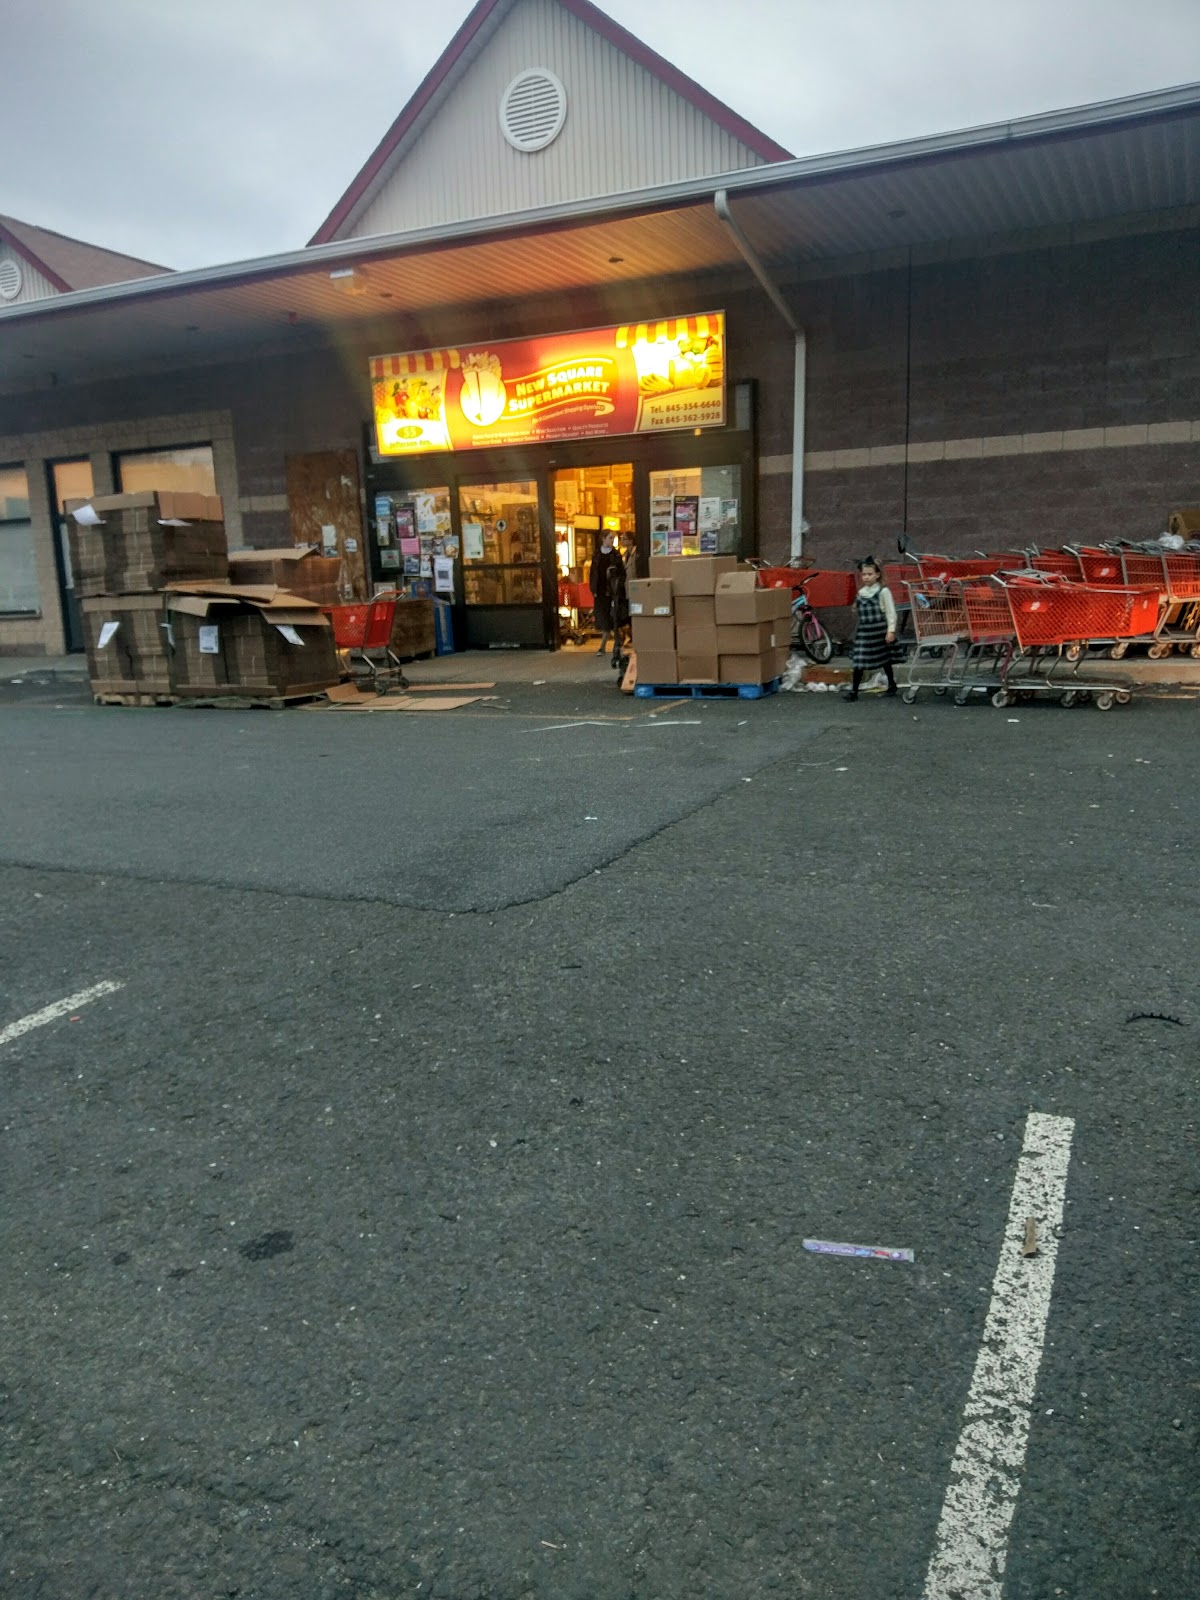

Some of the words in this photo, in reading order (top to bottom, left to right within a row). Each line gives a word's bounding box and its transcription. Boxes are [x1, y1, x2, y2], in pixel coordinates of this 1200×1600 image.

[515, 378, 545, 396] NEW
[547, 366, 603, 386] SQUARE
[508, 381, 610, 412] SUPERMARKET
[650, 417, 664, 426] Fax
